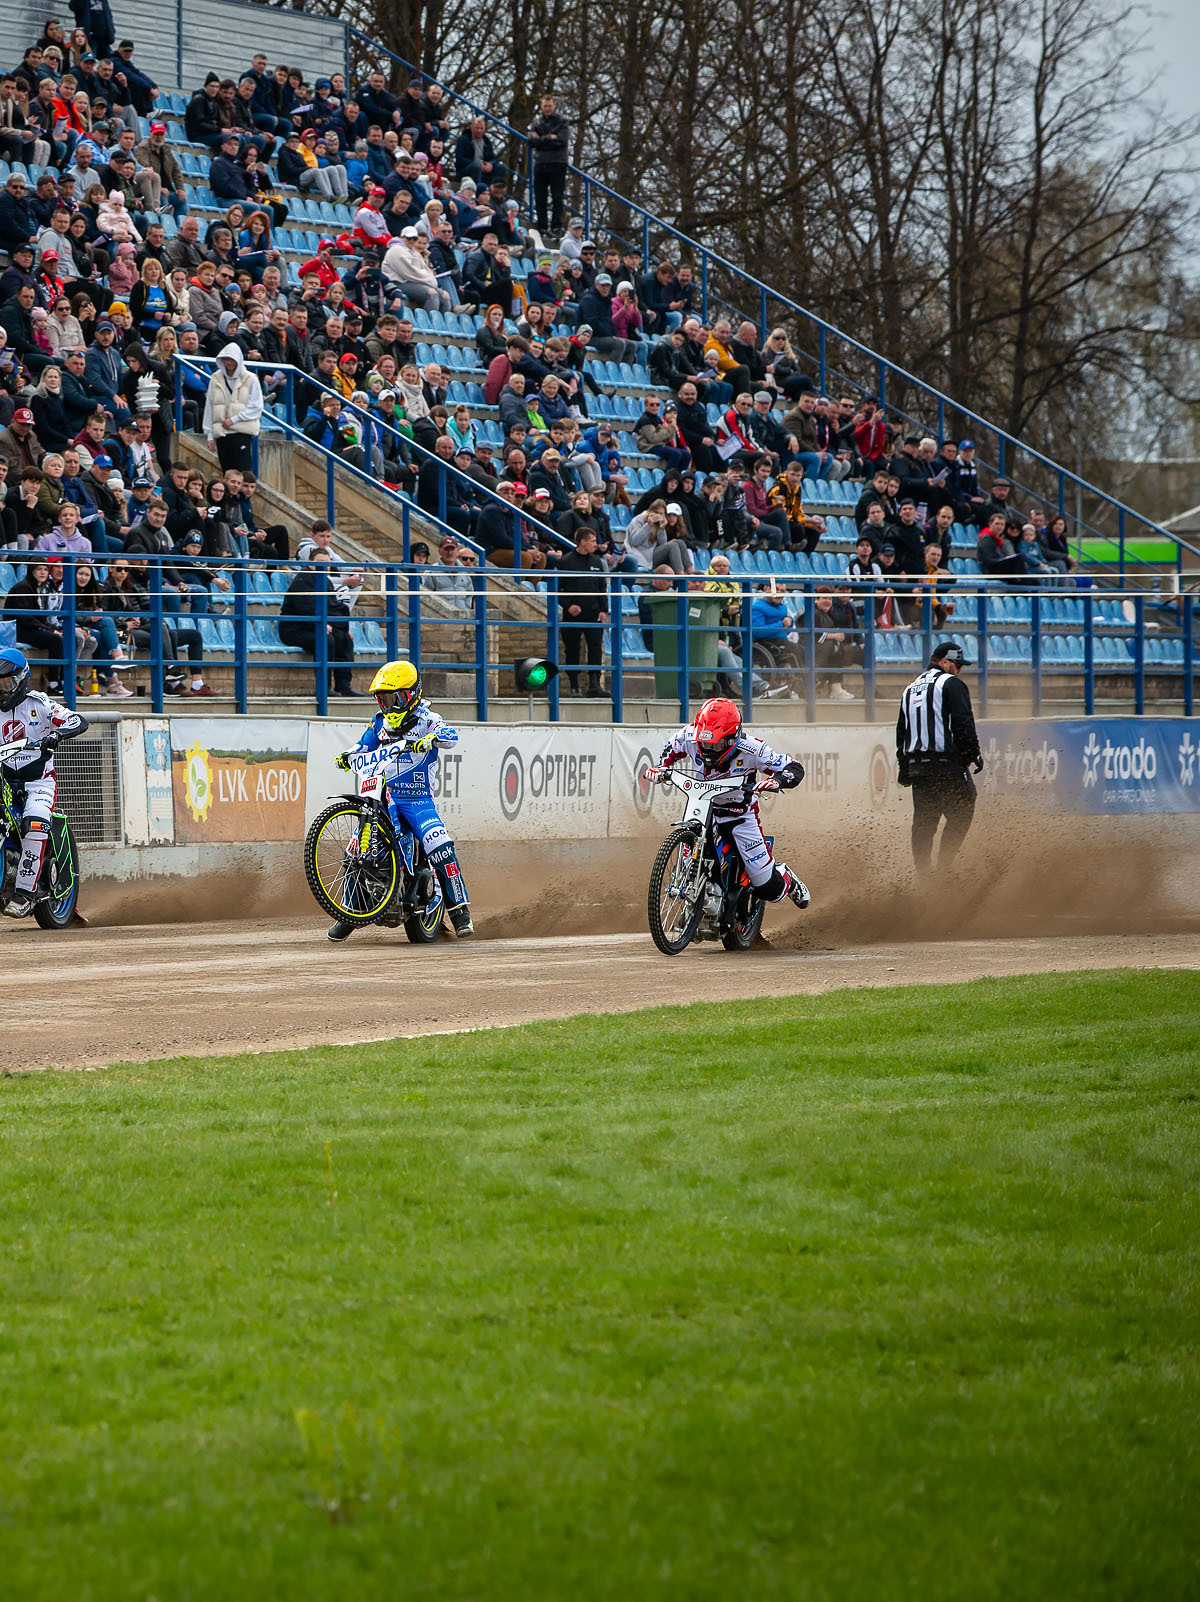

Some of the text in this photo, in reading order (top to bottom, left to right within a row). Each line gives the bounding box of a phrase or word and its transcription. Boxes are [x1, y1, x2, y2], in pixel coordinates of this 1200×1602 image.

[530, 754, 596, 798] OPTIBET
[1004, 740, 1059, 785] trodo
[1102, 737, 1157, 780] trodo
[218, 769, 300, 802] LVK AGRO
